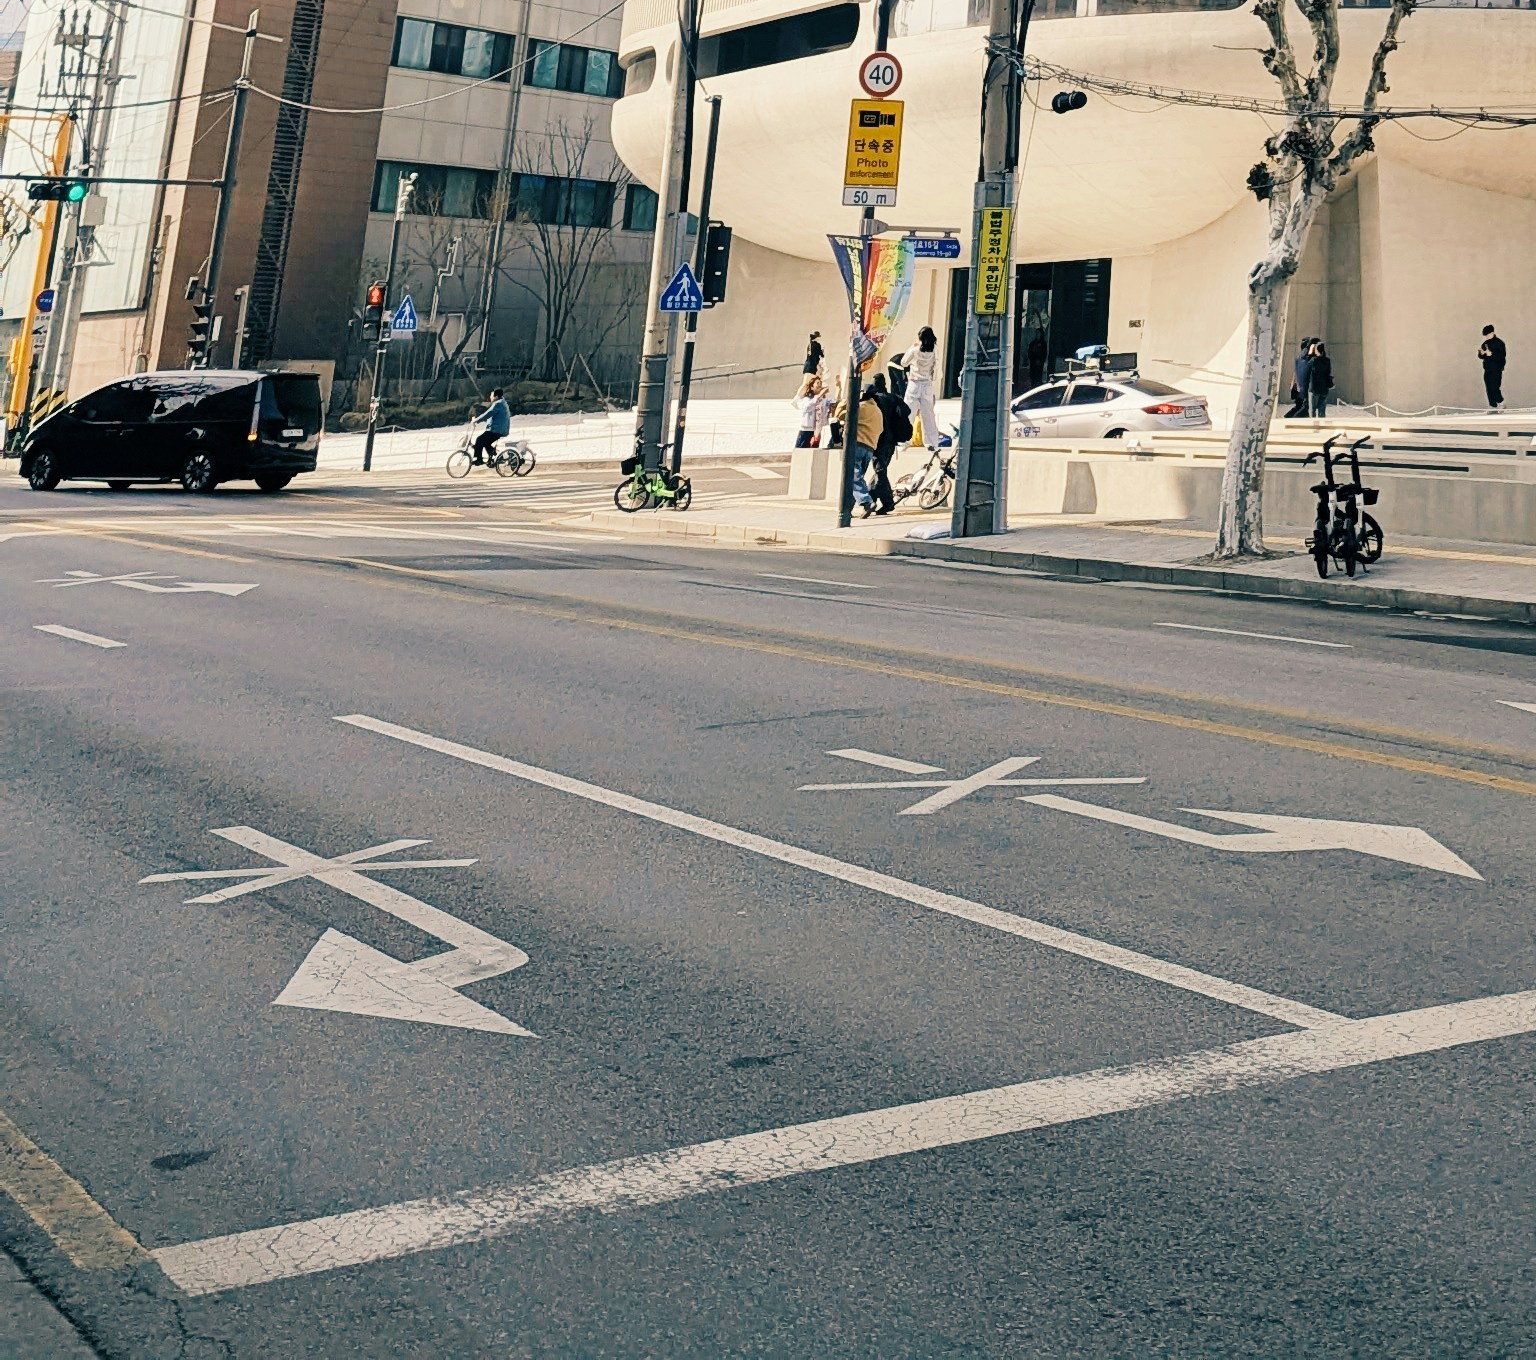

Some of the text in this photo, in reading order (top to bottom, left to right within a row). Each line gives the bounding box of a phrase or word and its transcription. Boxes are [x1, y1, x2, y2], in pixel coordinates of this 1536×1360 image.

[869, 65, 894, 85] 40
[854, 138, 894, 154] 단속중
[856, 157, 889, 168] Photo
[849, 169, 895, 179] enforcement
[853, 191, 887, 204] 50 m
